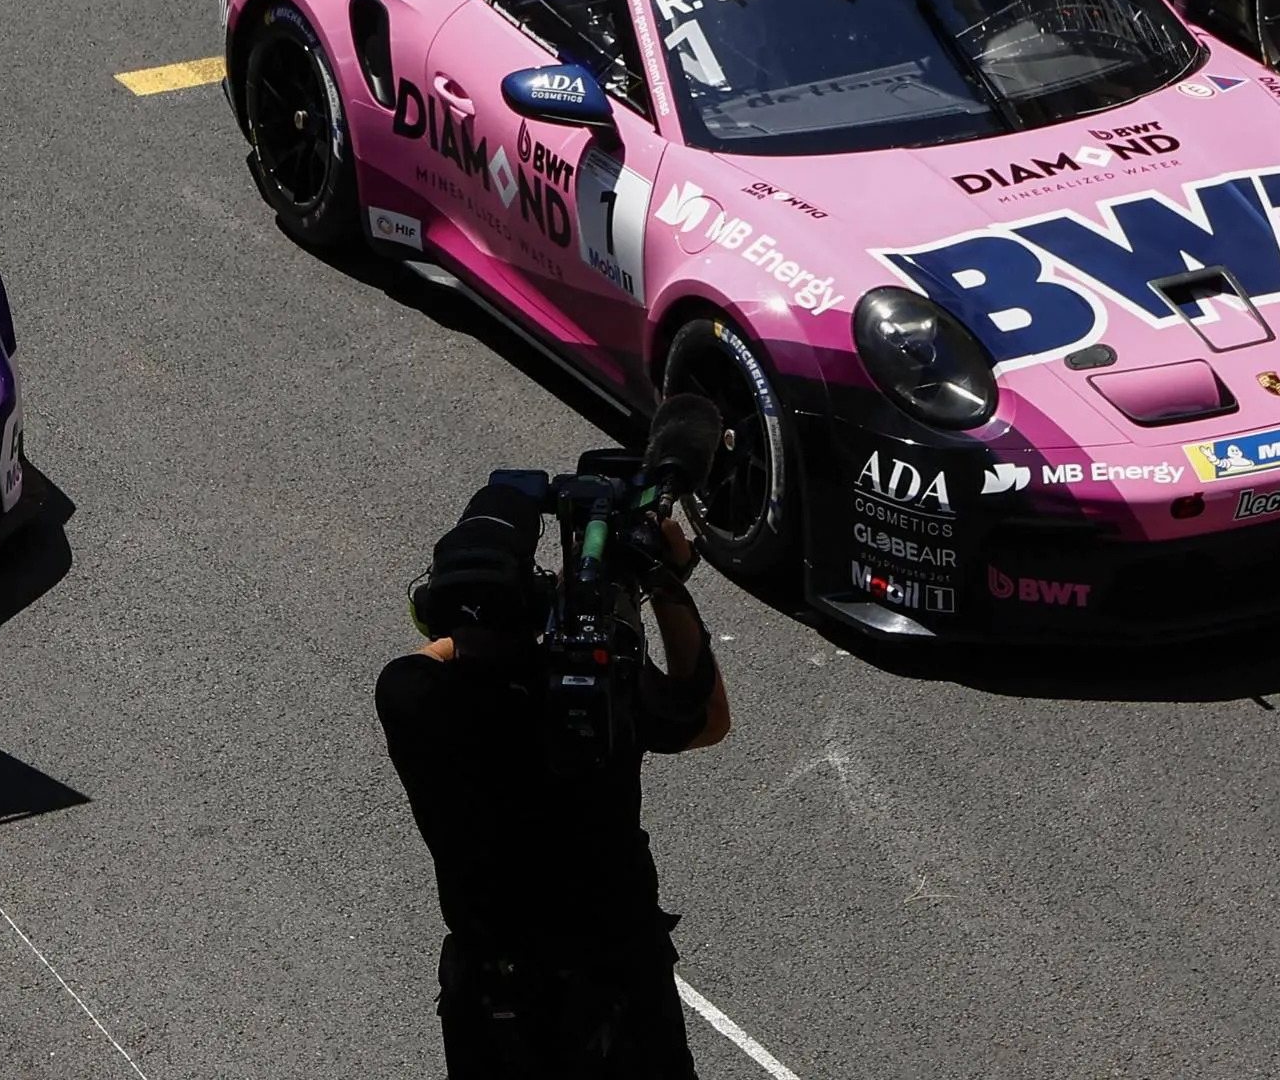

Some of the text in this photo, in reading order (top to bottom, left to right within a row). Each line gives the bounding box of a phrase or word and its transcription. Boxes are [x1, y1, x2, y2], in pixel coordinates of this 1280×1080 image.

[664, 18, 729, 87] 1
[531, 74, 585, 94] ADA
[531, 91, 583, 104] COSMETICS
[1112, 120, 1164, 139] BWT
[533, 140, 574, 193] BWT
[998, 158, 1183, 205] MINERALIZED WATER
[395, 222, 417, 238] HIF
[599, 189, 618, 256] 1
[588, 247, 621, 286] Mobil
[705, 212, 845, 317] MB Energy
[854, 450, 957, 514] ADA
[1041, 461, 1185, 485] MB Energy
[854, 497, 954, 539] COSMETICS
[851, 559, 944, 611] Mobil 1
[1018, 577, 1093, 608] BWT
